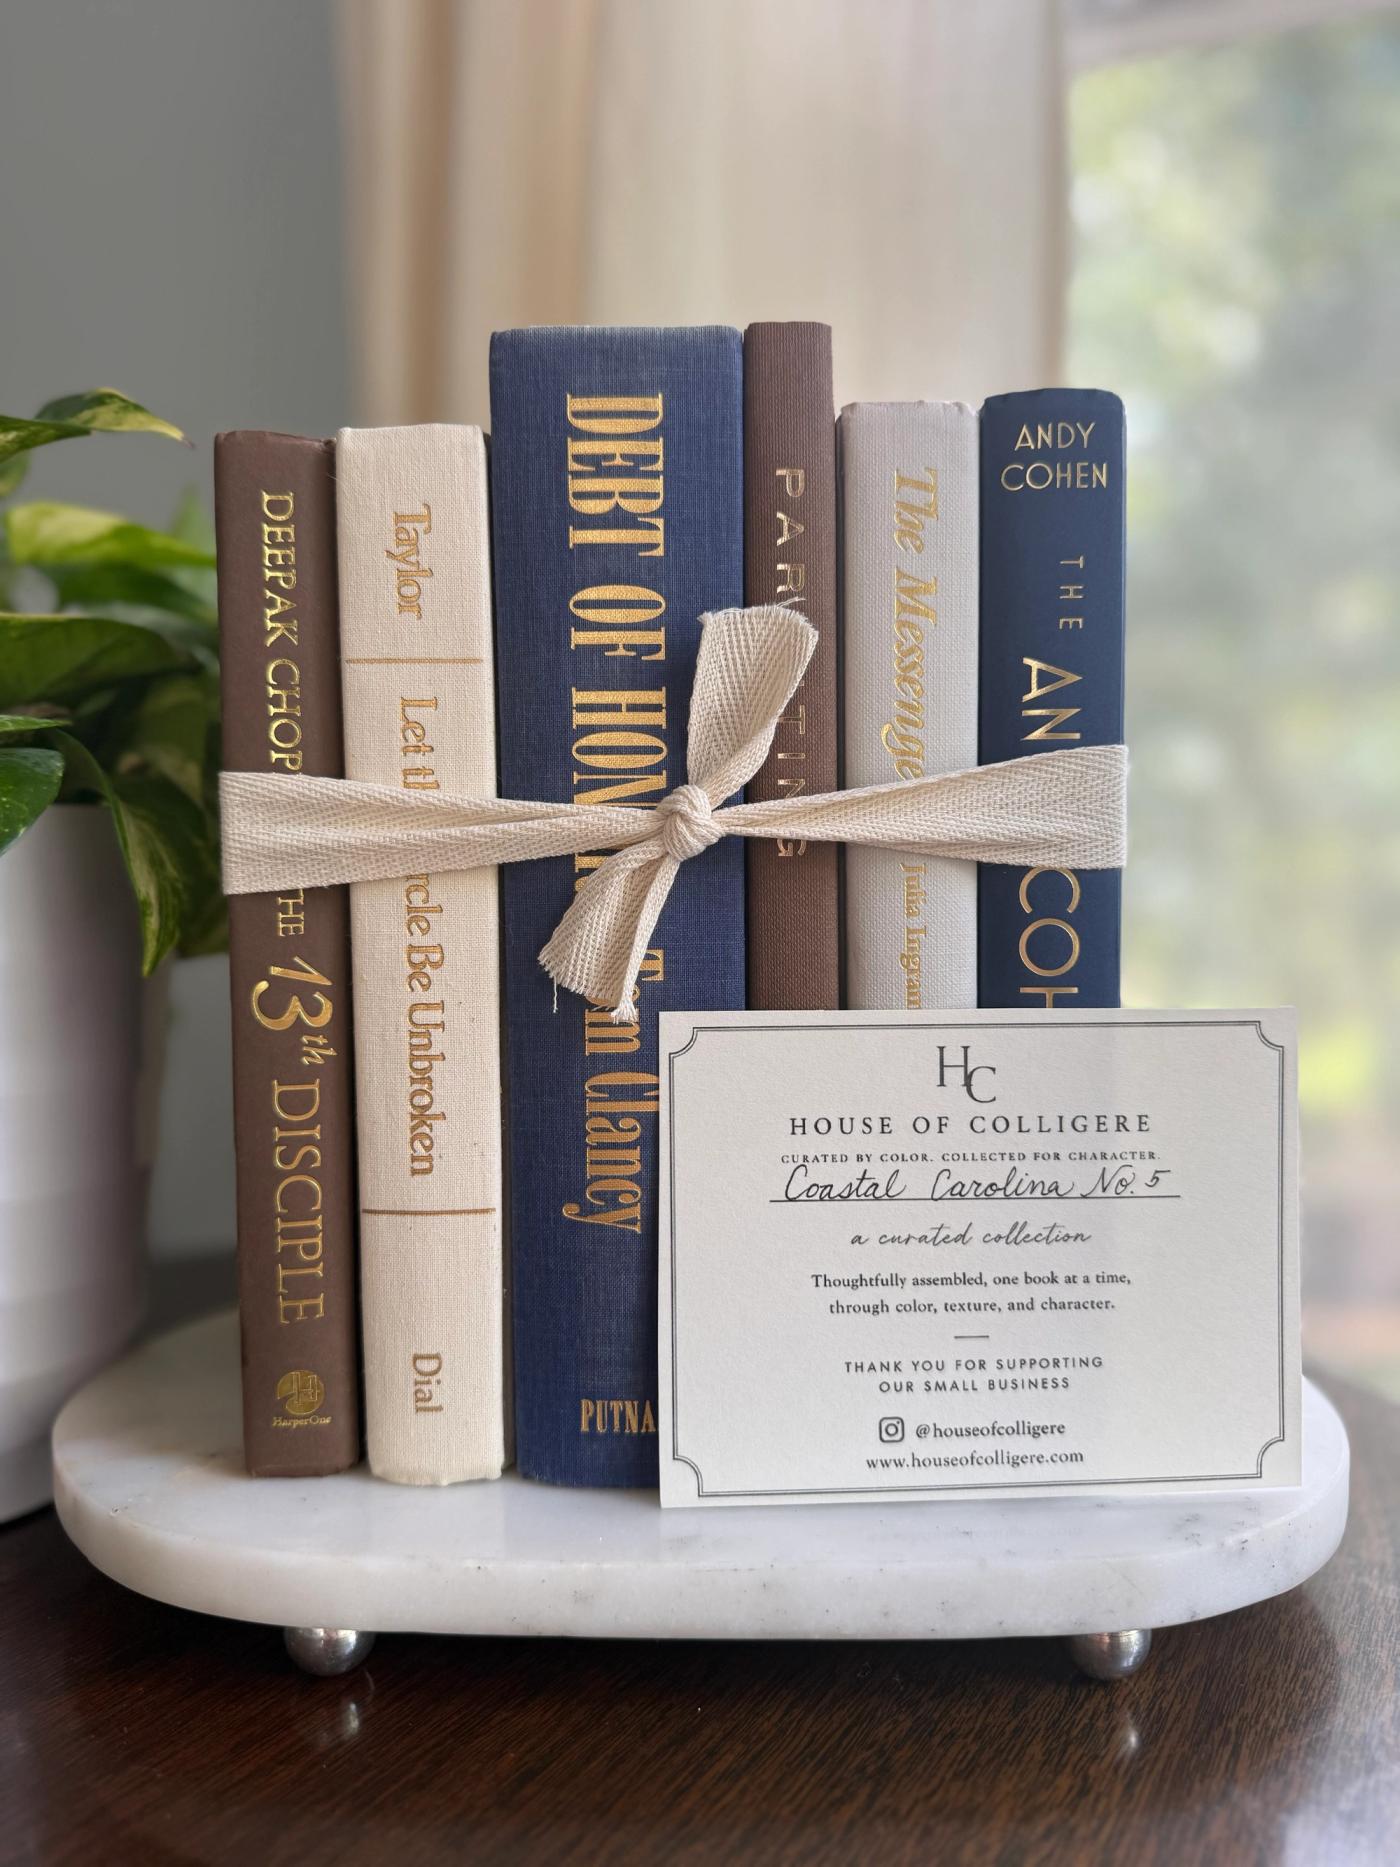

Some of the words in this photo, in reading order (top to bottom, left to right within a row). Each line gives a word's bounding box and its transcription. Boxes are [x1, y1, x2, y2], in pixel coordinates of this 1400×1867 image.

[1015, 422, 1095, 451] ANDY
[567, 393, 665, 557] DEBT
[1001, 463, 1108, 491] COHEN
[893, 468, 939, 554] The
[261, 490, 297, 647] DEEPAK
[385, 503, 434, 621] Taylor
[1058, 556, 1084, 630] THE
[569, 585, 666, 662] OF
[880, 568, 938, 780] Messenge
[1021, 657, 1083, 741] AN
[266, 658, 303, 772] CHOP
[400, 696, 438, 756] Let
[405, 873, 443, 936] rcle
[900, 863, 928, 917] Julia
[1019, 866, 1080, 1008] COH
[407, 943, 445, 992] Be
[252, 956, 338, 1065] 13th
[406, 1000, 447, 1177] Unbroken
[562, 1070, 659, 1234] Clancy
[789, 1116, 893, 1136] HOUSE
[912, 1115, 950, 1135] OF
[969, 1114, 1150, 1135] COLLIGERE
[780, 1153, 849, 1164] CURATED
[855, 1153, 873, 1163] BY
[879, 1152, 934, 1163] COLOR.
[940, 1151, 1027, 1162] COLLECTED
[1033, 1151, 1061, 1161] FOR
[1068, 1150, 1161, 1161] CHARACTER.
[784, 1164, 907, 1201] Coastal
[930, 1166, 1075, 1201] Carolina
[1143, 1168, 1172, 1188] 5
[272, 1079, 324, 1325] DISCIPLE
[850, 1234, 870, 1246] a
[878, 1221, 973, 1247] curated
[982, 1220, 1092, 1245] collection
[810, 1272, 907, 1291] Thoughtfully
[911, 1271, 988, 1288] assembled,
[992, 1275, 1019, 1286] one
[1023, 1270, 1060, 1285] book
[1063, 1274, 1078, 1285] at
[1082, 1274, 1091, 1285] a
[1095, 1270, 1132, 1285] time,
[829, 1298, 890, 1317] through
[895, 1298, 938, 1315] color,
[943, 1301, 1002, 1313] texture,
[1007, 1296, 1035, 1312] and
[1040, 1296, 1116, 1311] character.
[412, 1352, 444, 1414] Dial
[844, 1360, 903, 1374] THANK
[911, 1359, 945, 1372] YOU
[955, 1358, 987, 1372] FOR
[995, 1356, 1103, 1371] SUPPORTING
[878, 1380, 914, 1394] OUR
[923, 1379, 979, 1393] SMALL
[987, 1376, 1070, 1391] BUSINESS
[272, 1415, 332, 1429] HarperOne
[580, 1398, 657, 1433] PUTNA
[915, 1419, 1066, 1440] @houseofcolligere
[865, 1449, 1084, 1469] www.houseofcolligere.com
